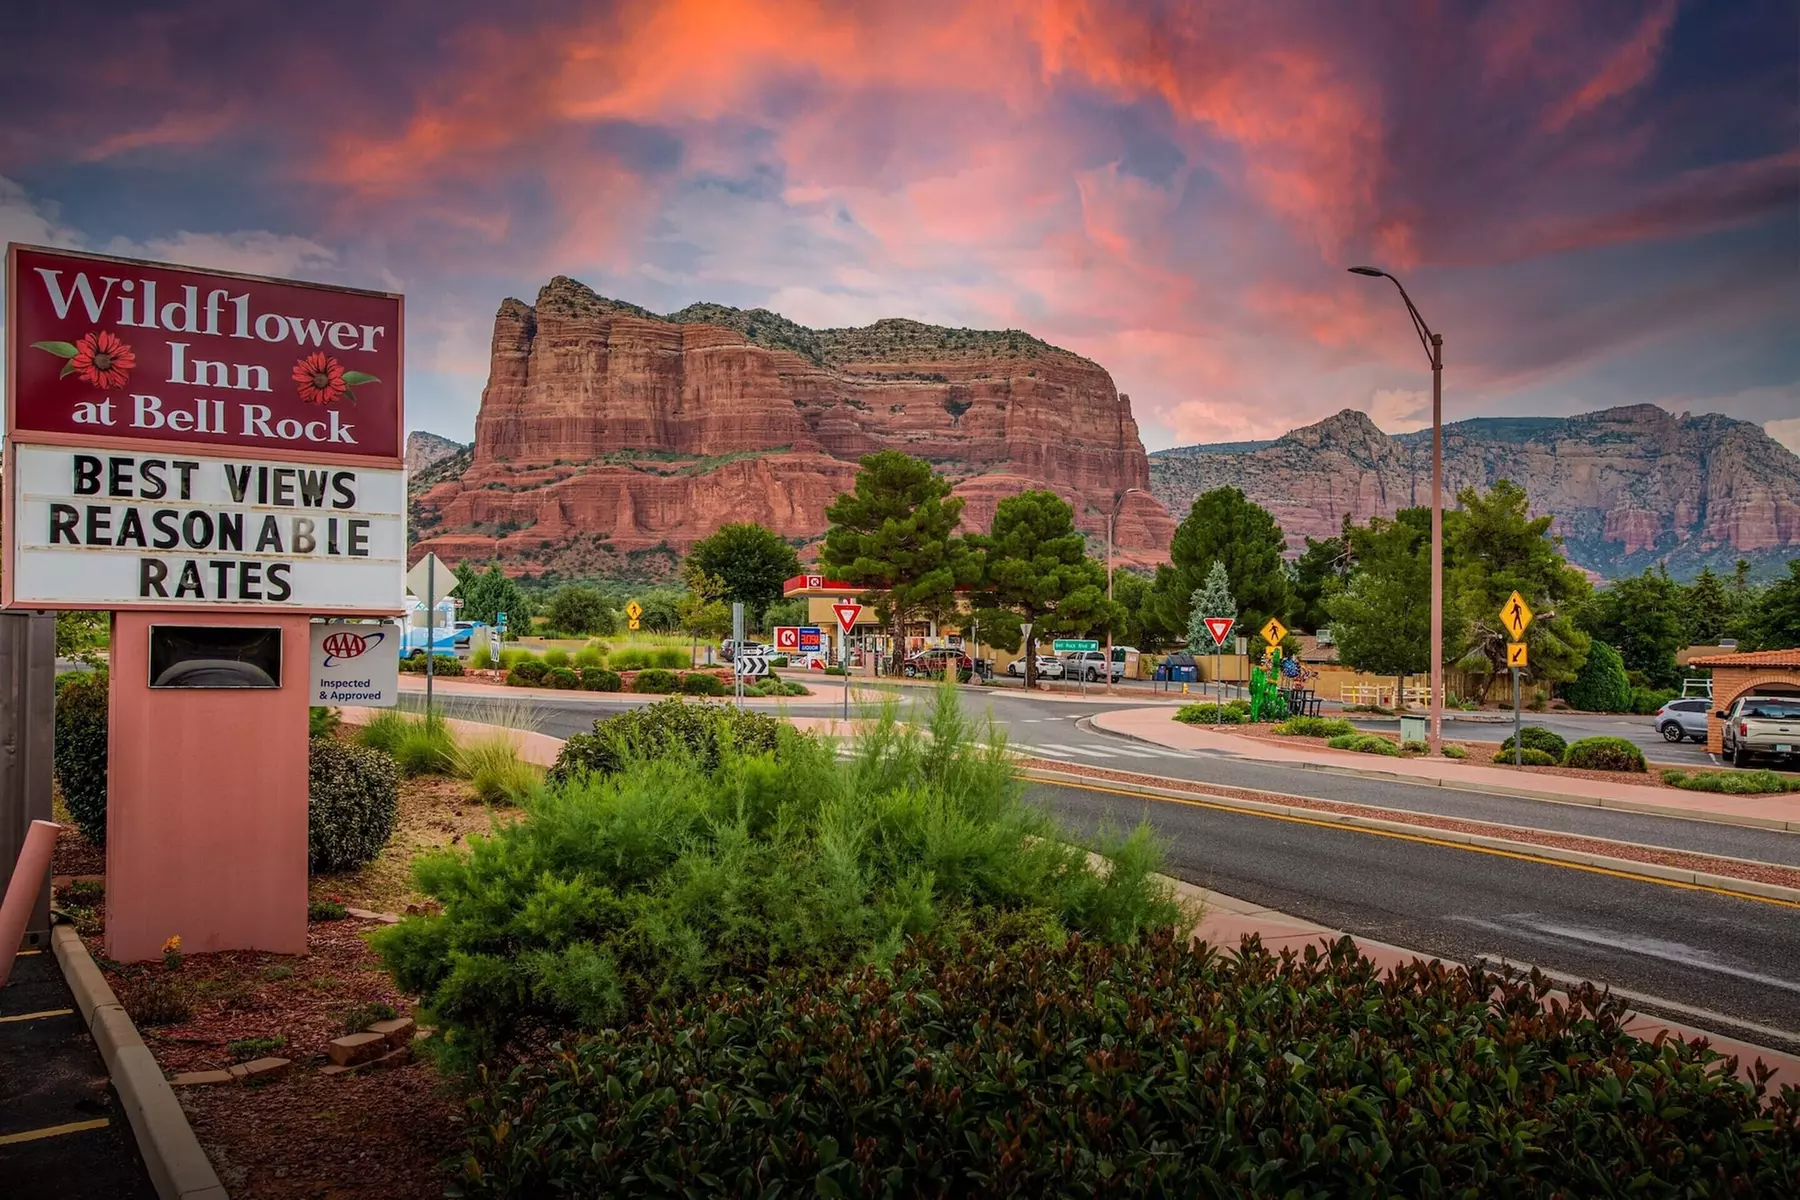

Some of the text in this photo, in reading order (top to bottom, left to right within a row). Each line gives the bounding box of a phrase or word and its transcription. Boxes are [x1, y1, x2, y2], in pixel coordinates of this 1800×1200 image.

[34, 267, 385, 353] Wildflower
[166, 341, 273, 393] Inn
[72, 394, 359, 444] at Bell Rock
[73, 455, 356, 509] BEST VIEWS
[50, 503, 371, 557] REASONABLE
[140, 558, 292, 602] RATES
[325, 633, 364, 658] AAA
[319, 691, 381, 702] & Approved
[320, 679, 370, 689] Inspected
